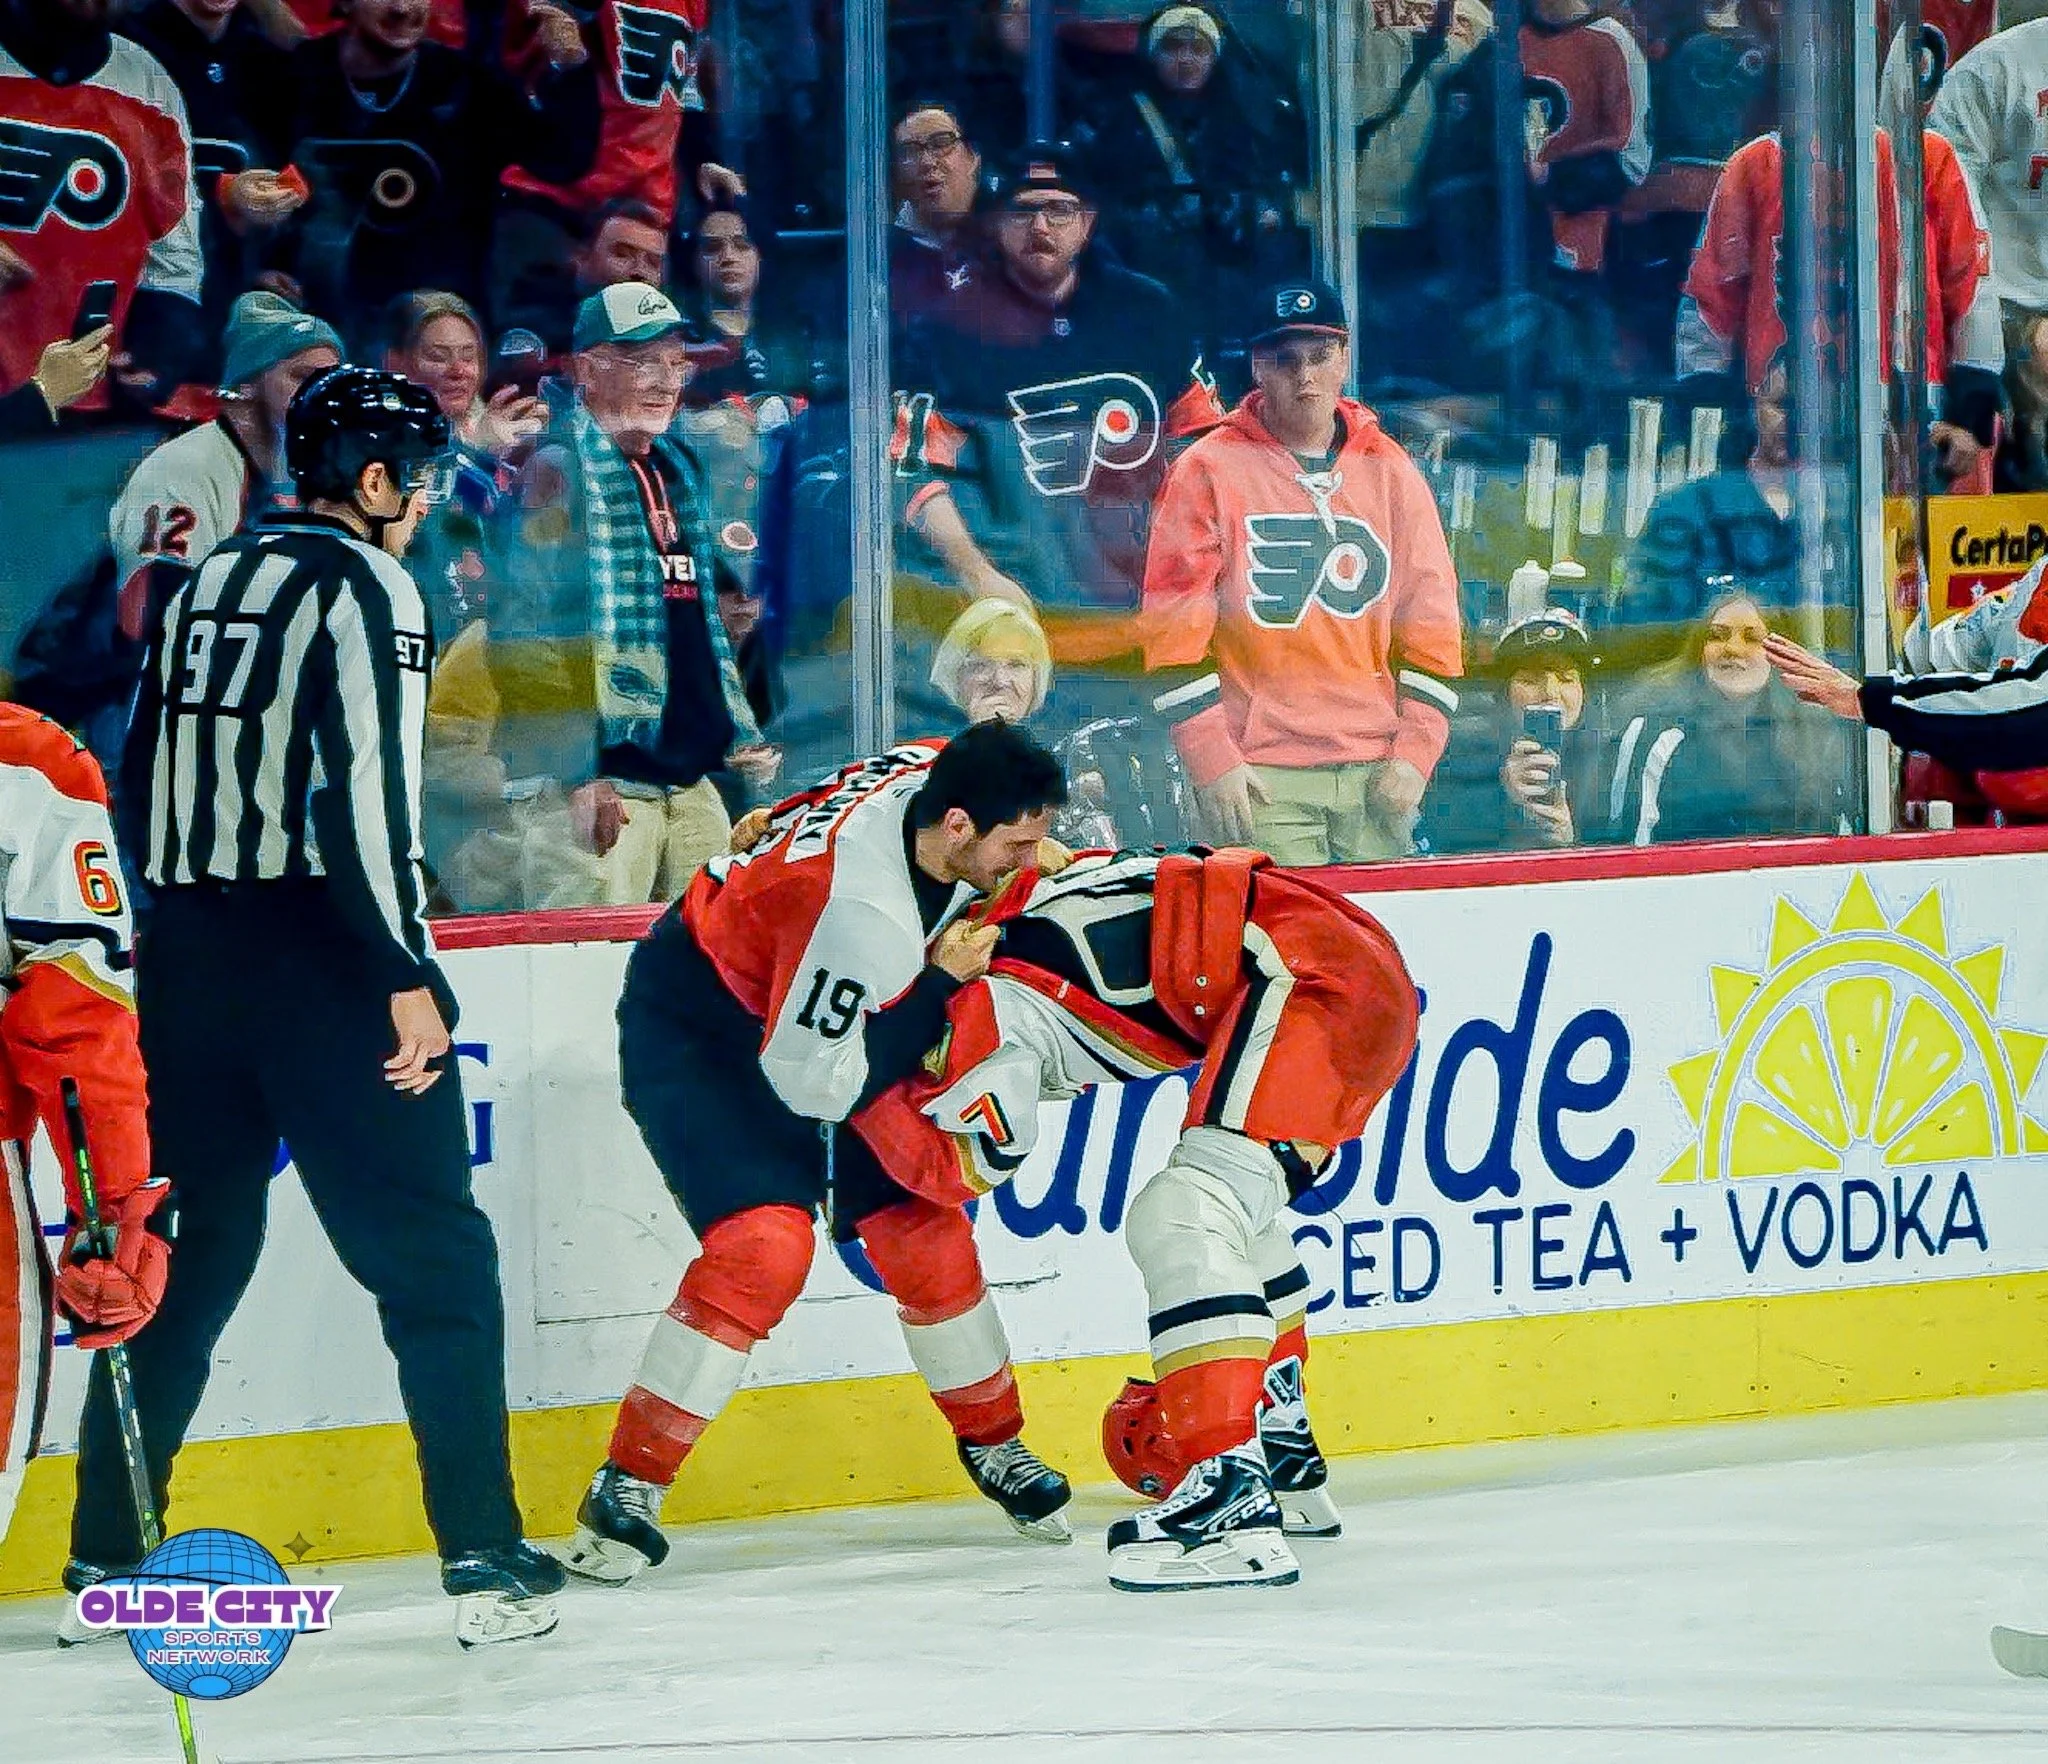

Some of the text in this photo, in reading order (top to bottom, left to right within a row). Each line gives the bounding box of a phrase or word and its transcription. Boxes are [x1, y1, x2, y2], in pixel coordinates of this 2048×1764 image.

[138, 504, 197, 556] 12
[181, 619, 261, 709] 97
[395, 635, 426, 668] 97
[73, 840, 124, 917] 6
[796, 967, 866, 1039] 19
[958, 1091, 1015, 1146] 7
[1290, 1171, 1988, 1315] CED TEA + VODKA
